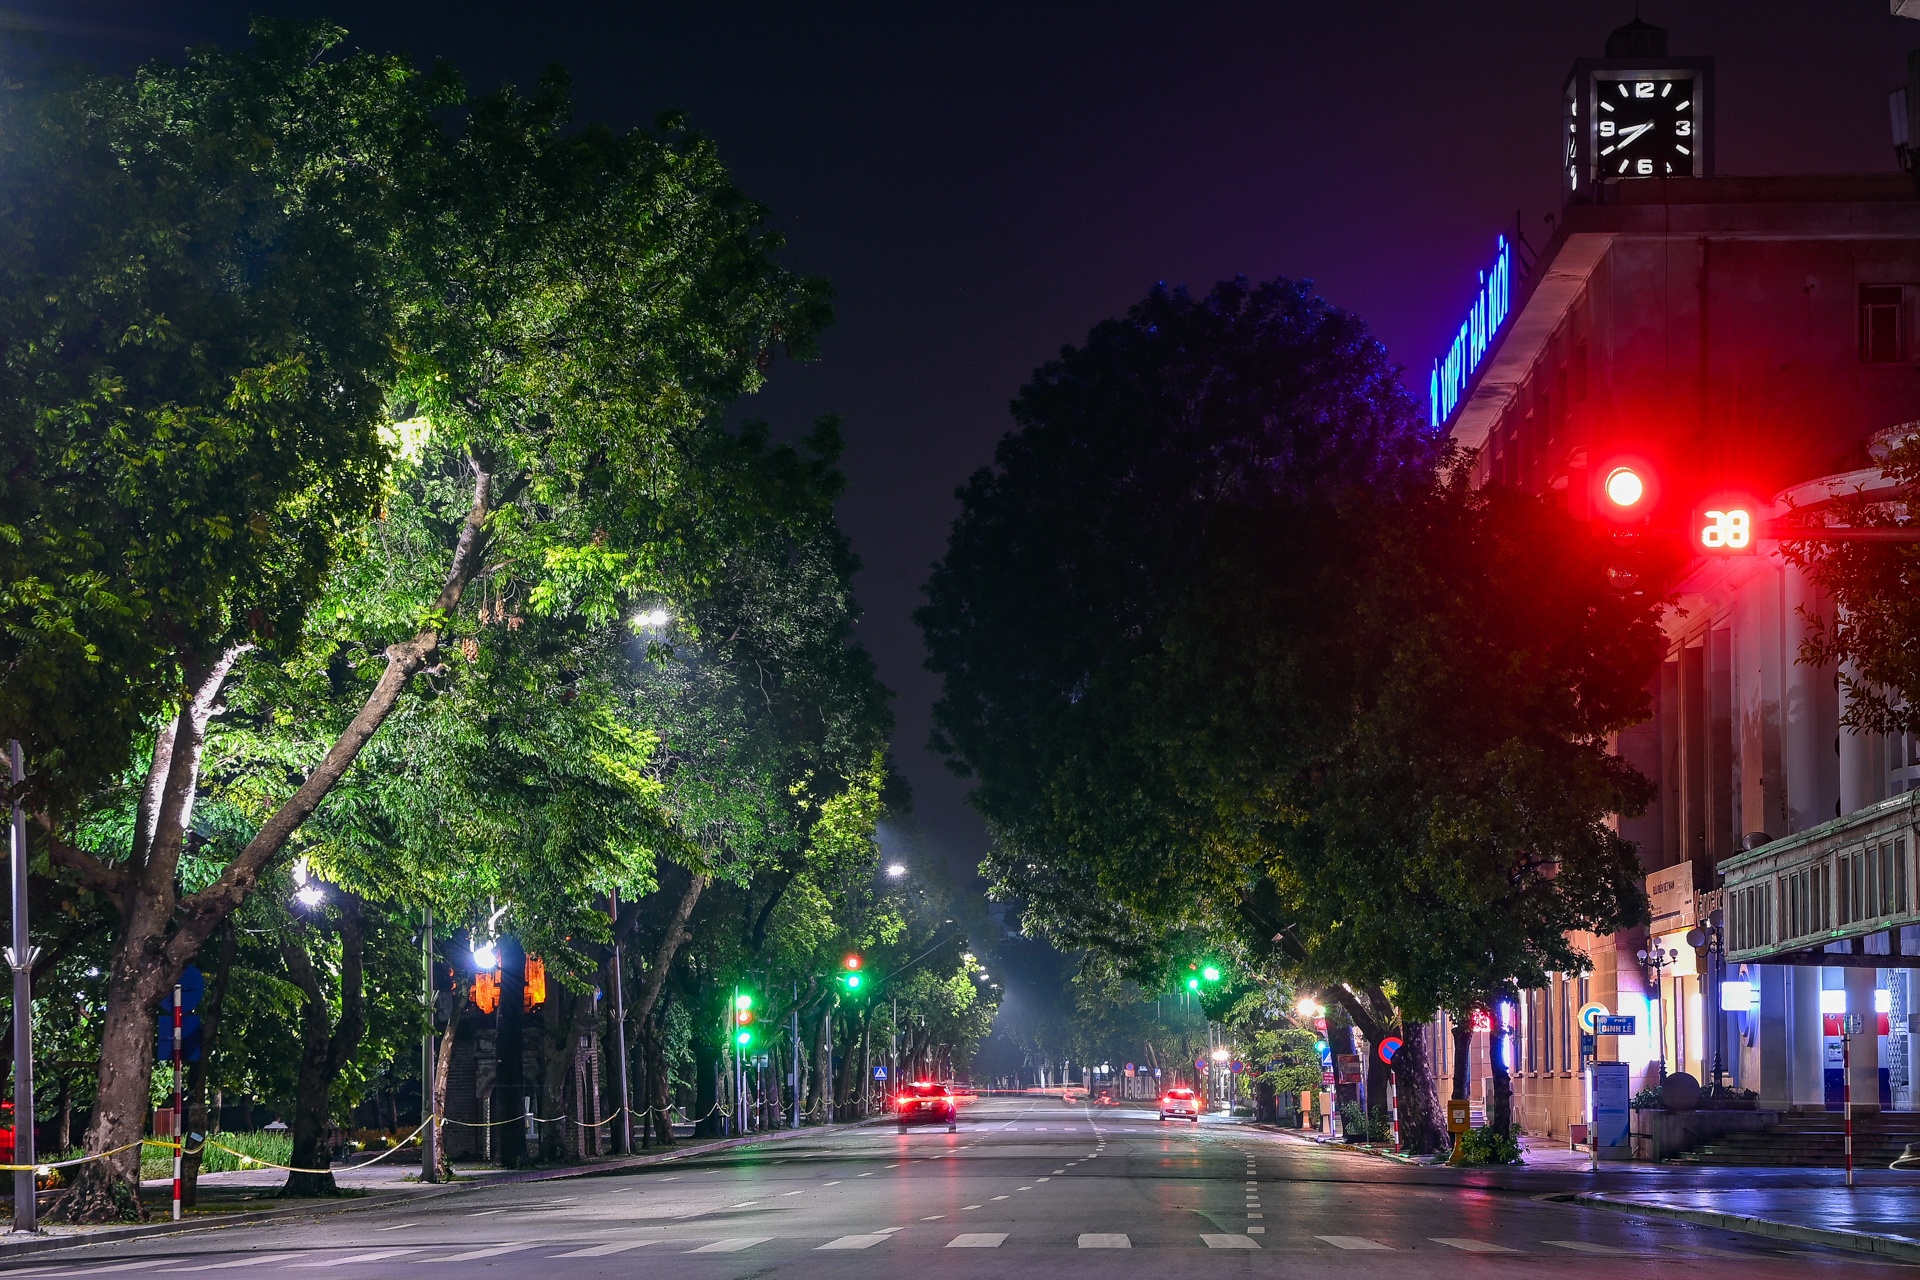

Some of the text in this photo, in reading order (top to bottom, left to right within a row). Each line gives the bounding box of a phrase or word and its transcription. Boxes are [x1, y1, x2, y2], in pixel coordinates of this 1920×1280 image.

[1635, 82, 1655, 98] 12
[1599, 121, 1615, 137] 9
[1675, 120, 1691, 136] 3
[1637, 159, 1653, 175] 6
